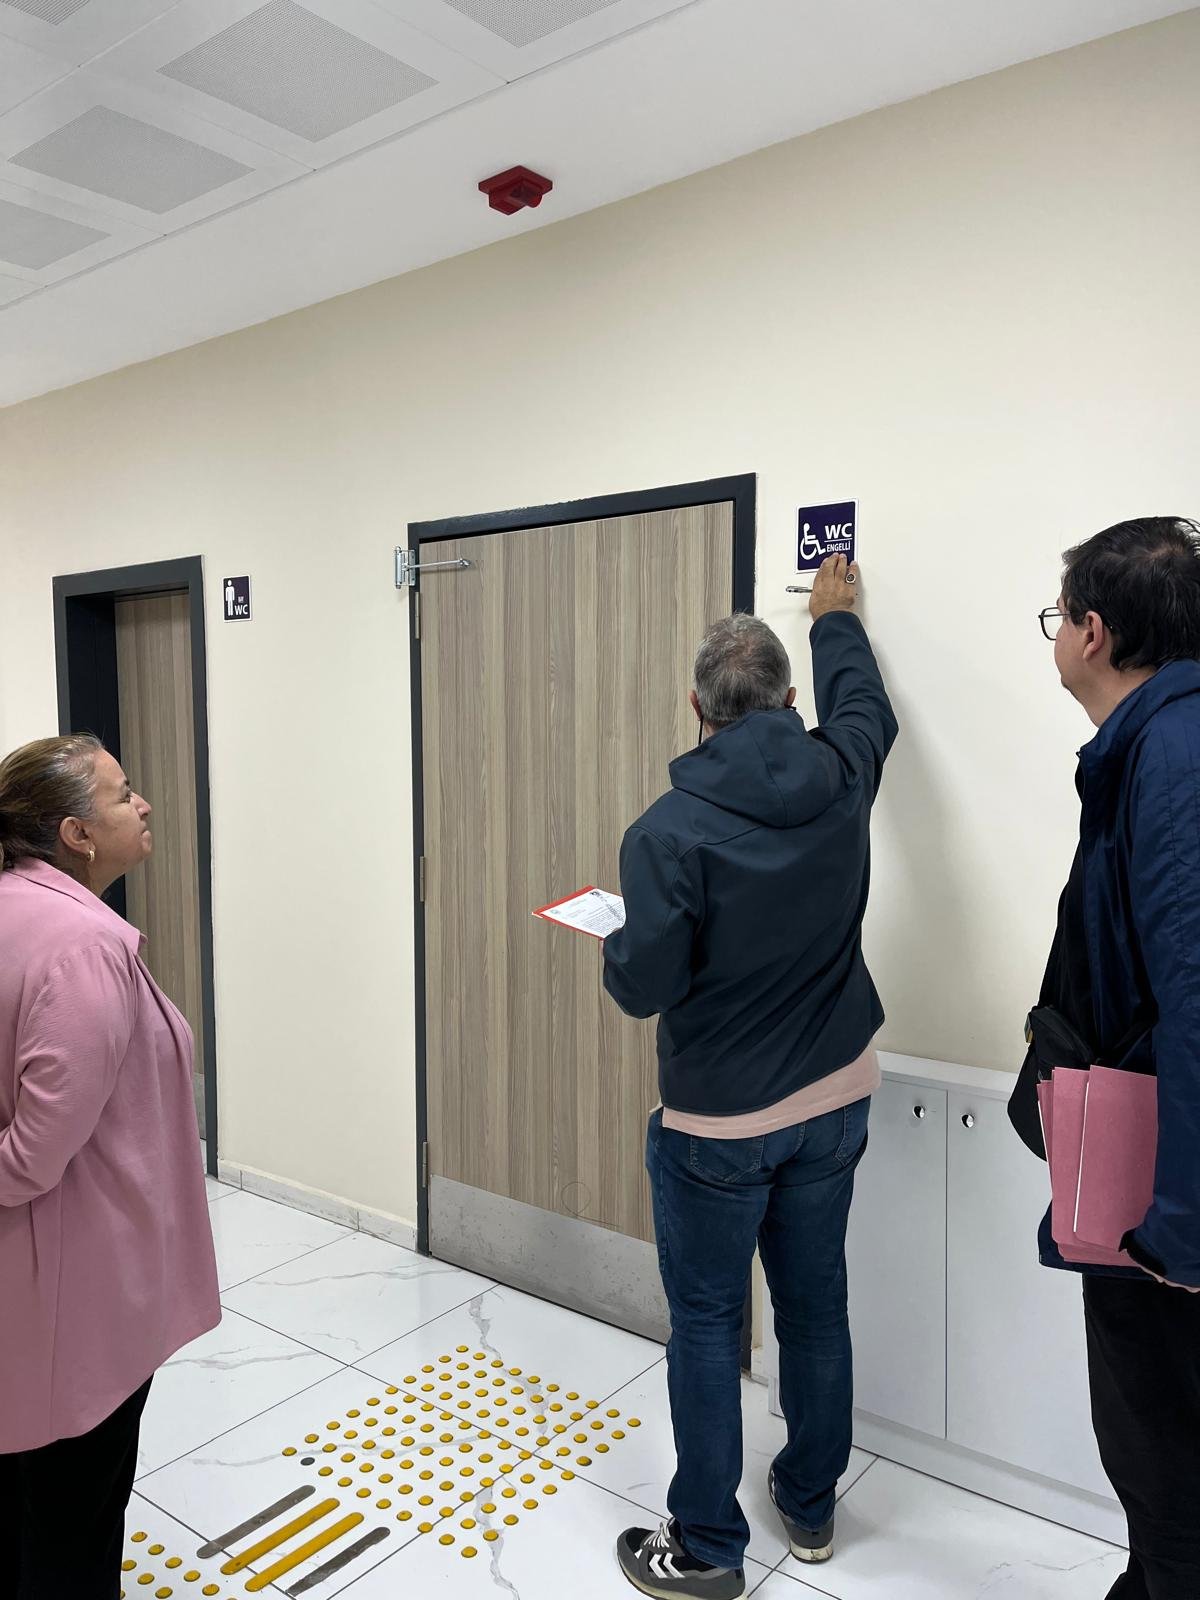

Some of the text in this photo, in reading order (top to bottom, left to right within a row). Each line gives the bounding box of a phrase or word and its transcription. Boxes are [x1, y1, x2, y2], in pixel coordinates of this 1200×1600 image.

[824, 523, 853, 539] WC
[826, 541, 851, 552] ENGELLİ
[234, 604, 248, 615] WC
